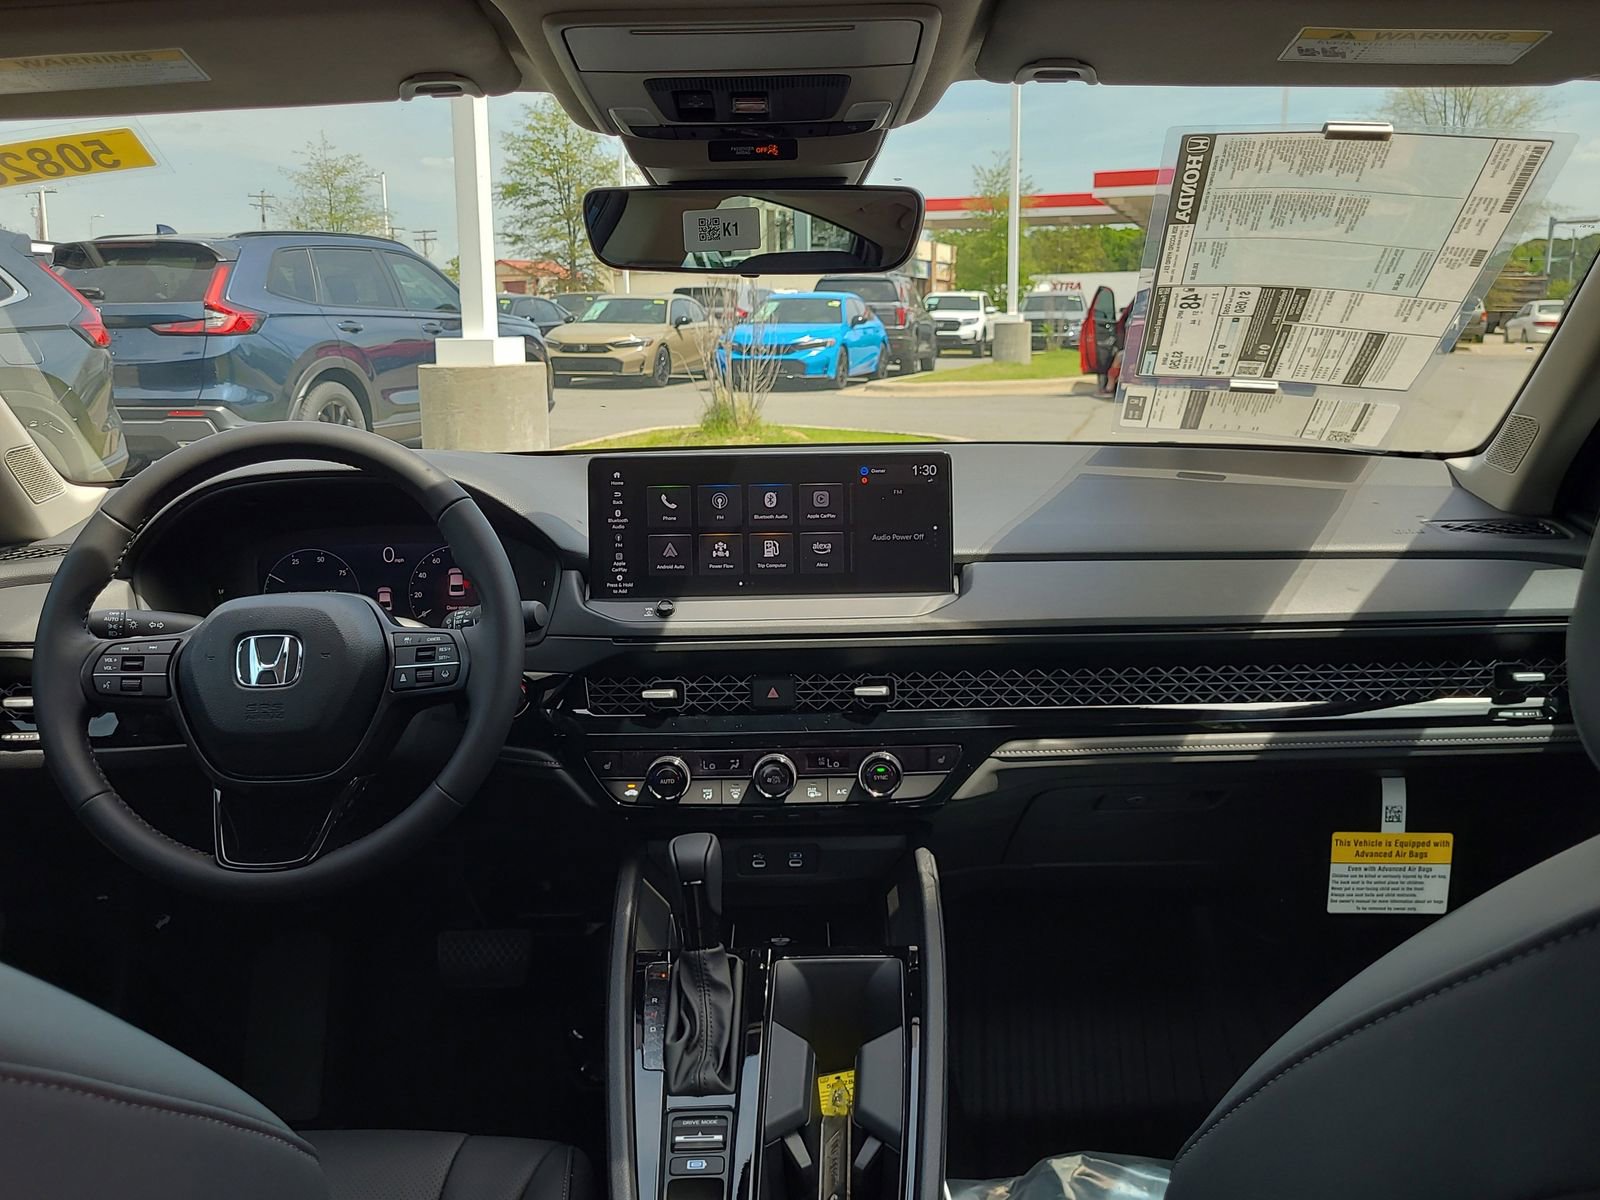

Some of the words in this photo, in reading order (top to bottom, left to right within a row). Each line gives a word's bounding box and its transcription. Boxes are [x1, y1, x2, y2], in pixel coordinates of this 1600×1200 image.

[1374, 31, 1512, 41] WARNING
[15, 53, 153, 69] WARNING
[723, 221, 739, 238] K1
[912, 465, 937, 476] 1:30
[812, 542, 831, 550] alexa
[382, 546, 395, 563] 0
[291, 557, 300, 565] 25
[703, 761, 715, 770] Lo
[827, 759, 839, 767] Lo
[1335, 839, 1351, 847] This
[1354, 839, 1382, 847] Vehicle
[1394, 840, 1430, 849] Equipped
[1354, 850, 1392, 858] Advanced
[1395, 850, 1406, 858] Air
[1408, 850, 1428, 859] Bags
